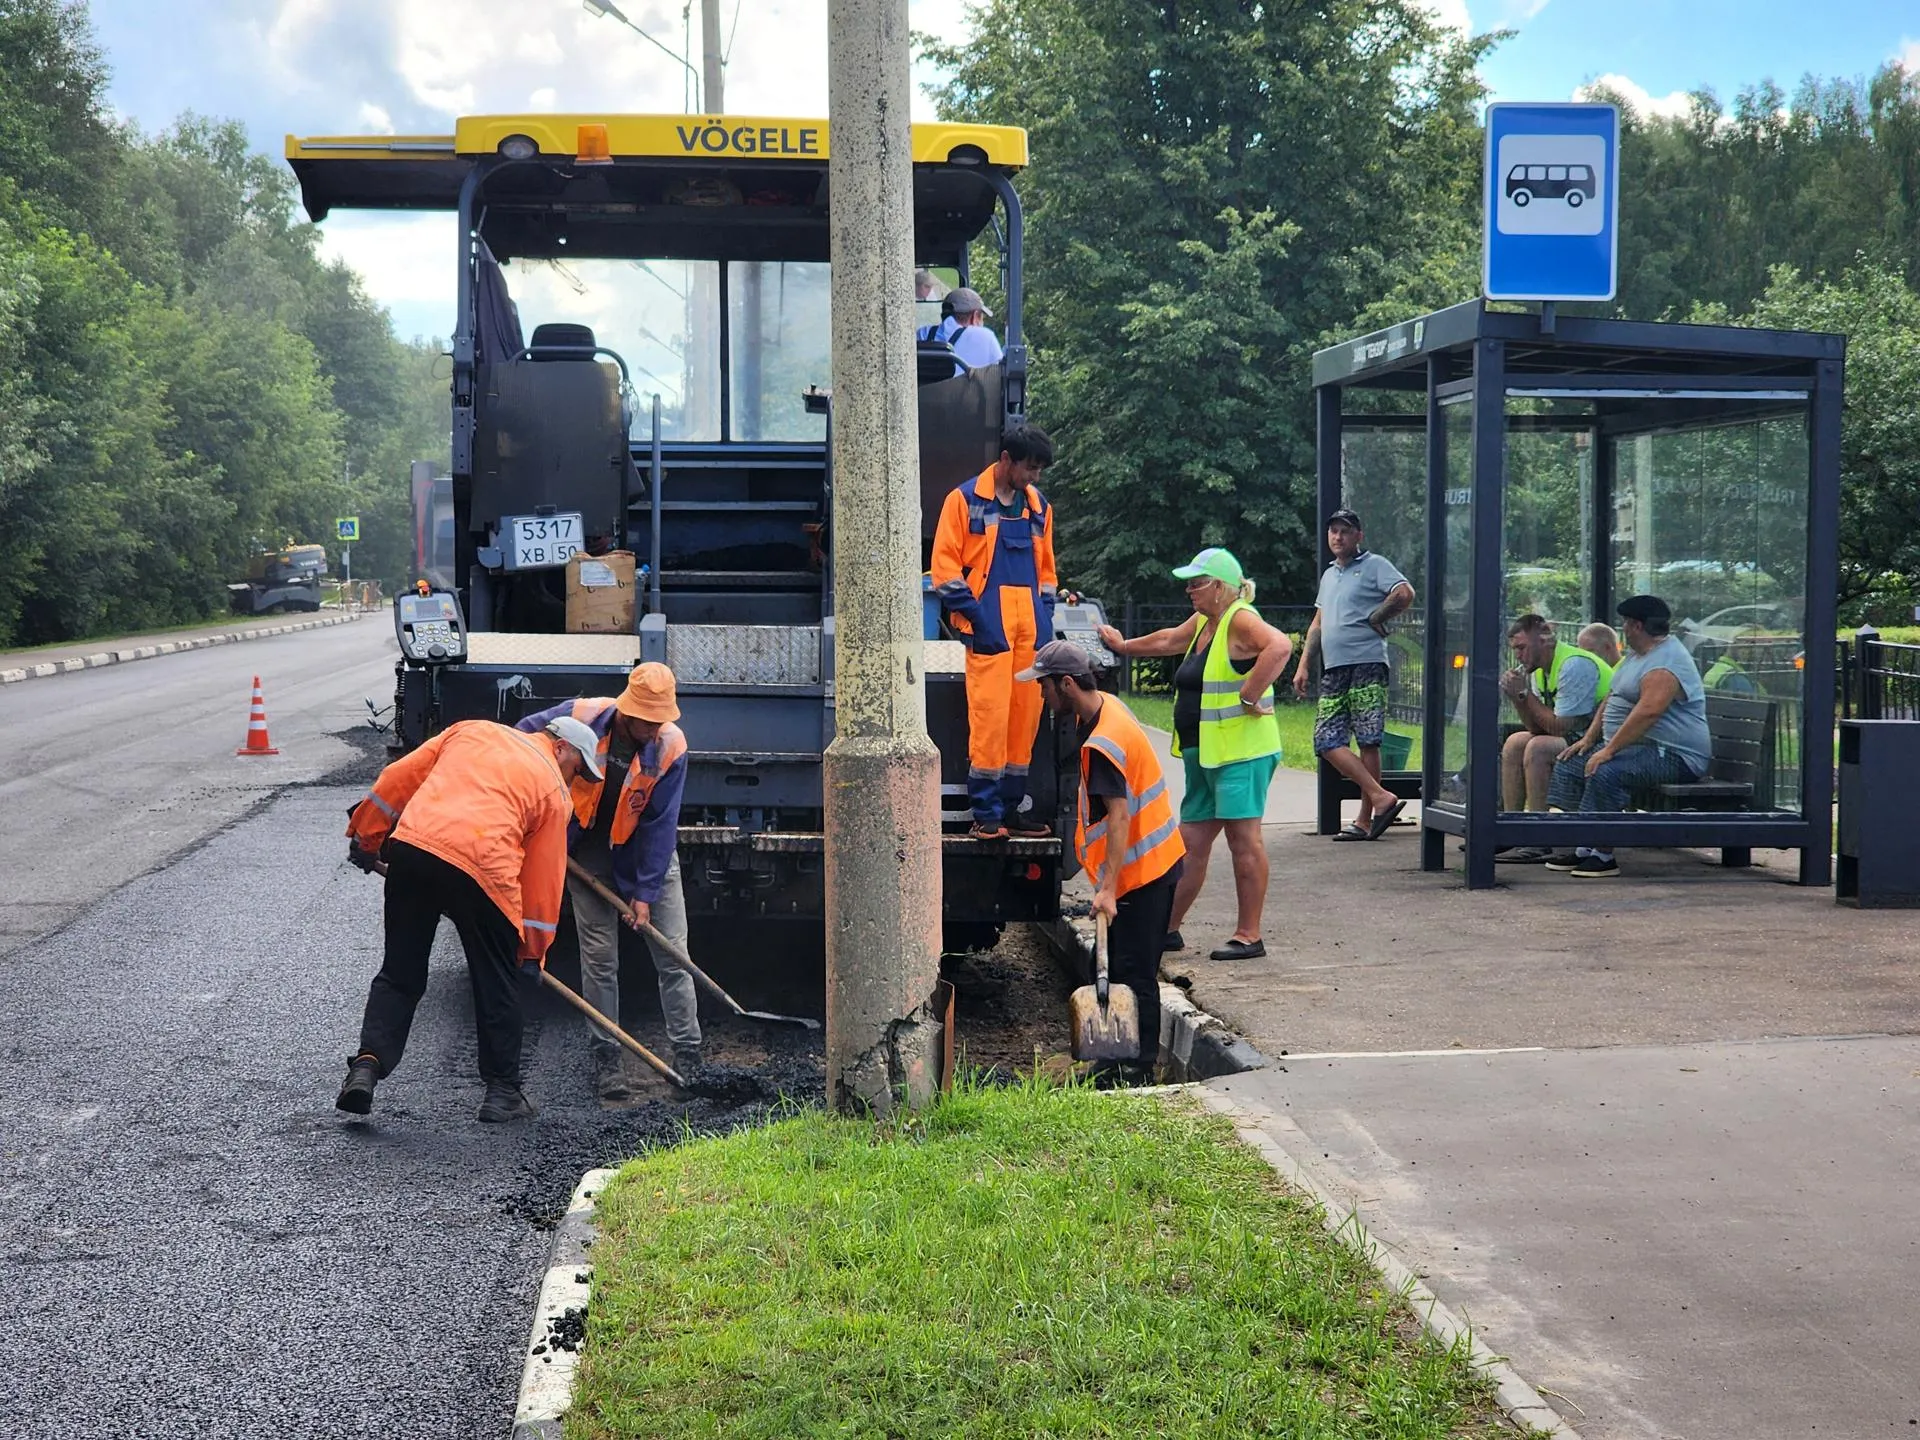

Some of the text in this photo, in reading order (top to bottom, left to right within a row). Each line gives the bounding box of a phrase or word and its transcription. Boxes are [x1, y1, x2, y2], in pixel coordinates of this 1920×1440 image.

[676, 119, 819, 154] VÖGELE
[522, 519, 572, 541] 5317
[558, 545, 577, 560] 50
